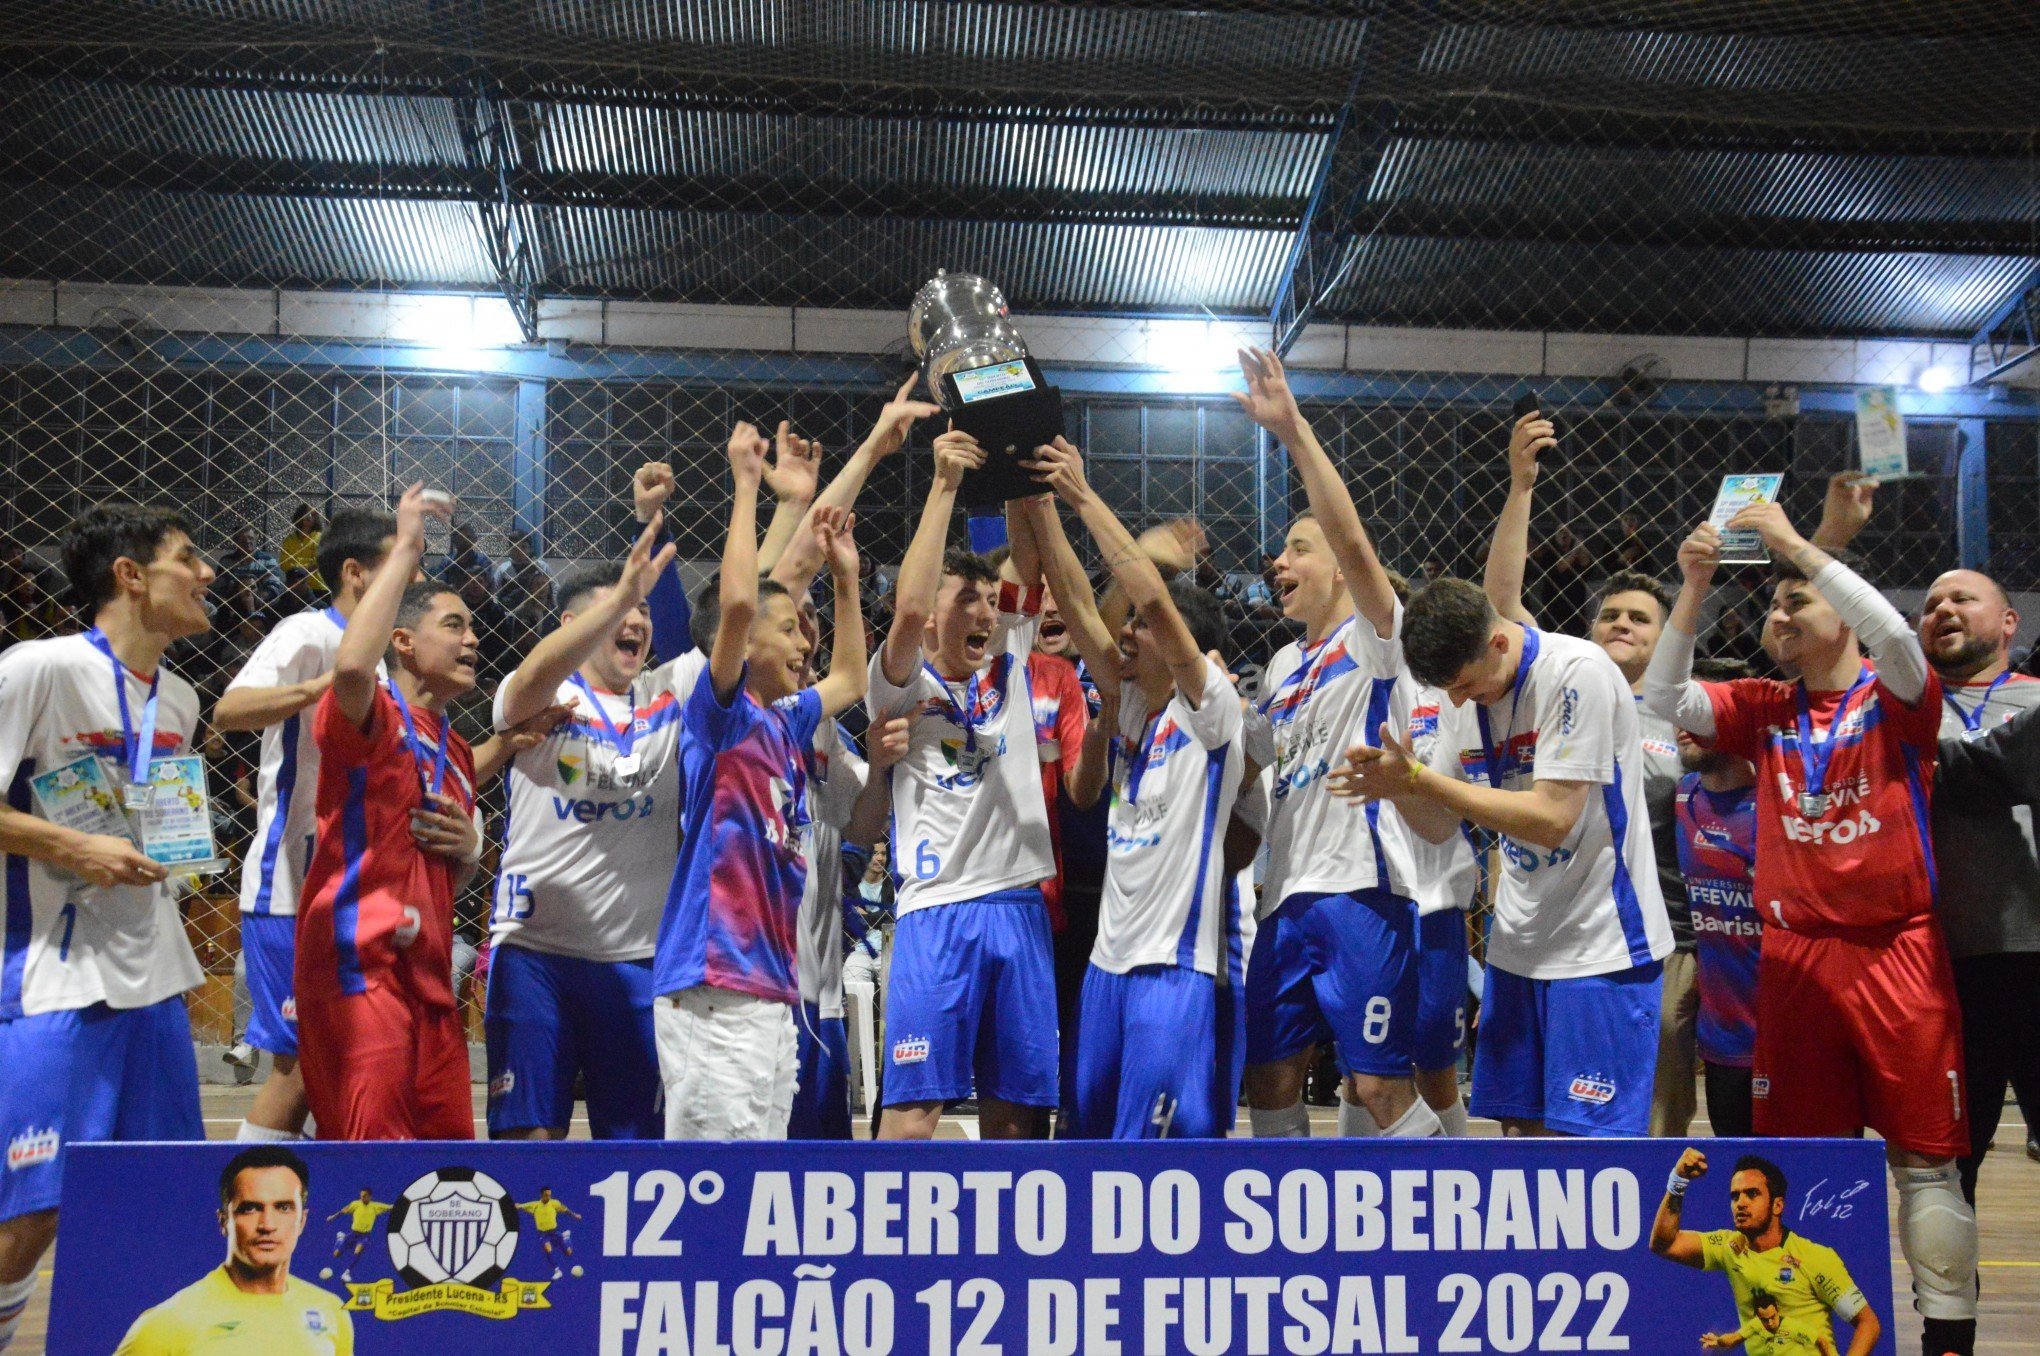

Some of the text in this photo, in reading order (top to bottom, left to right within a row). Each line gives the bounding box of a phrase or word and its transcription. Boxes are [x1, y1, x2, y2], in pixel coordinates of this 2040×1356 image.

[553, 796, 636, 823] vero
[916, 838, 941, 880] 6
[506, 874, 535, 919] 15
[1362, 995, 1392, 1044] 8
[895, 1044, 927, 1060] UJR
[1947, 1070, 1962, 1121] 1
[429, 1209, 483, 1218] SOBERANO
[449, 1200, 461, 1208] SE
[742, 1169, 1067, 1256] ABERTO
[1092, 1169, 1201, 1255] DO
[1223, 1167, 1641, 1255] SOBERANO
[386, 1286, 444, 1305] Presidente
[446, 1285, 484, 1302] Lucena
[494, 1292, 508, 1304] RS
[600, 1263, 1630, 1356] FALCÃO 12 DE FUTSAL 2022
